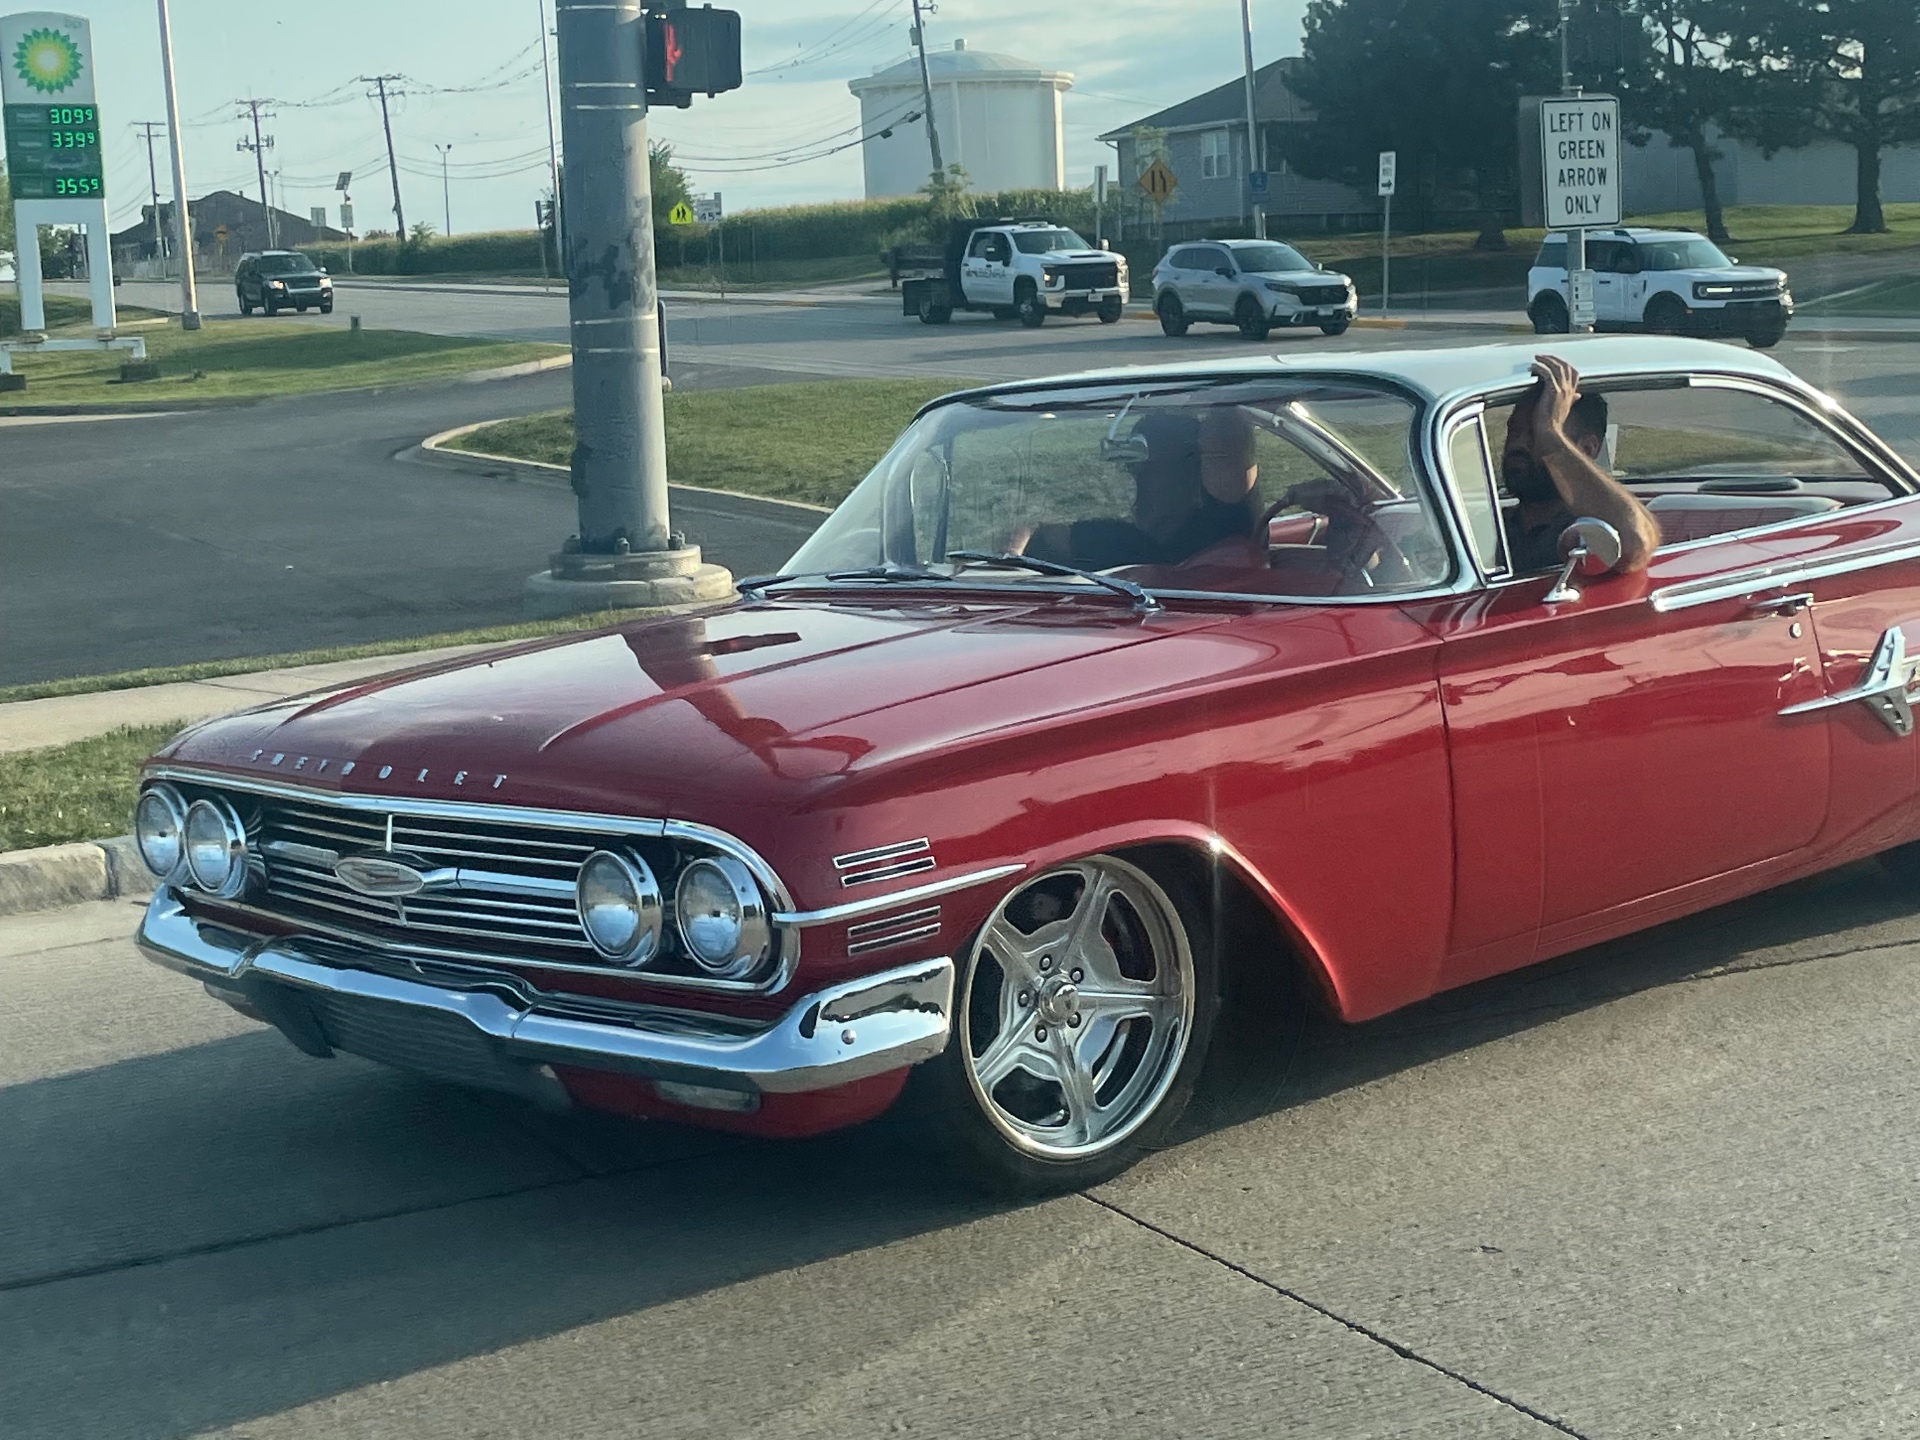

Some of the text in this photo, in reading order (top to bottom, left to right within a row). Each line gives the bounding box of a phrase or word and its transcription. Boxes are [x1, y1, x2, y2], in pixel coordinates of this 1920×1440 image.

[50, 108, 93, 124] 3099
[1550, 111, 1611, 132] LEFT ON
[52, 132, 95, 148] 3399
[1558, 140, 1605, 159] GREEN
[56, 178, 99, 194] 3559
[1558, 167, 1607, 187] ARROW
[1565, 194, 1602, 215] ONLY
